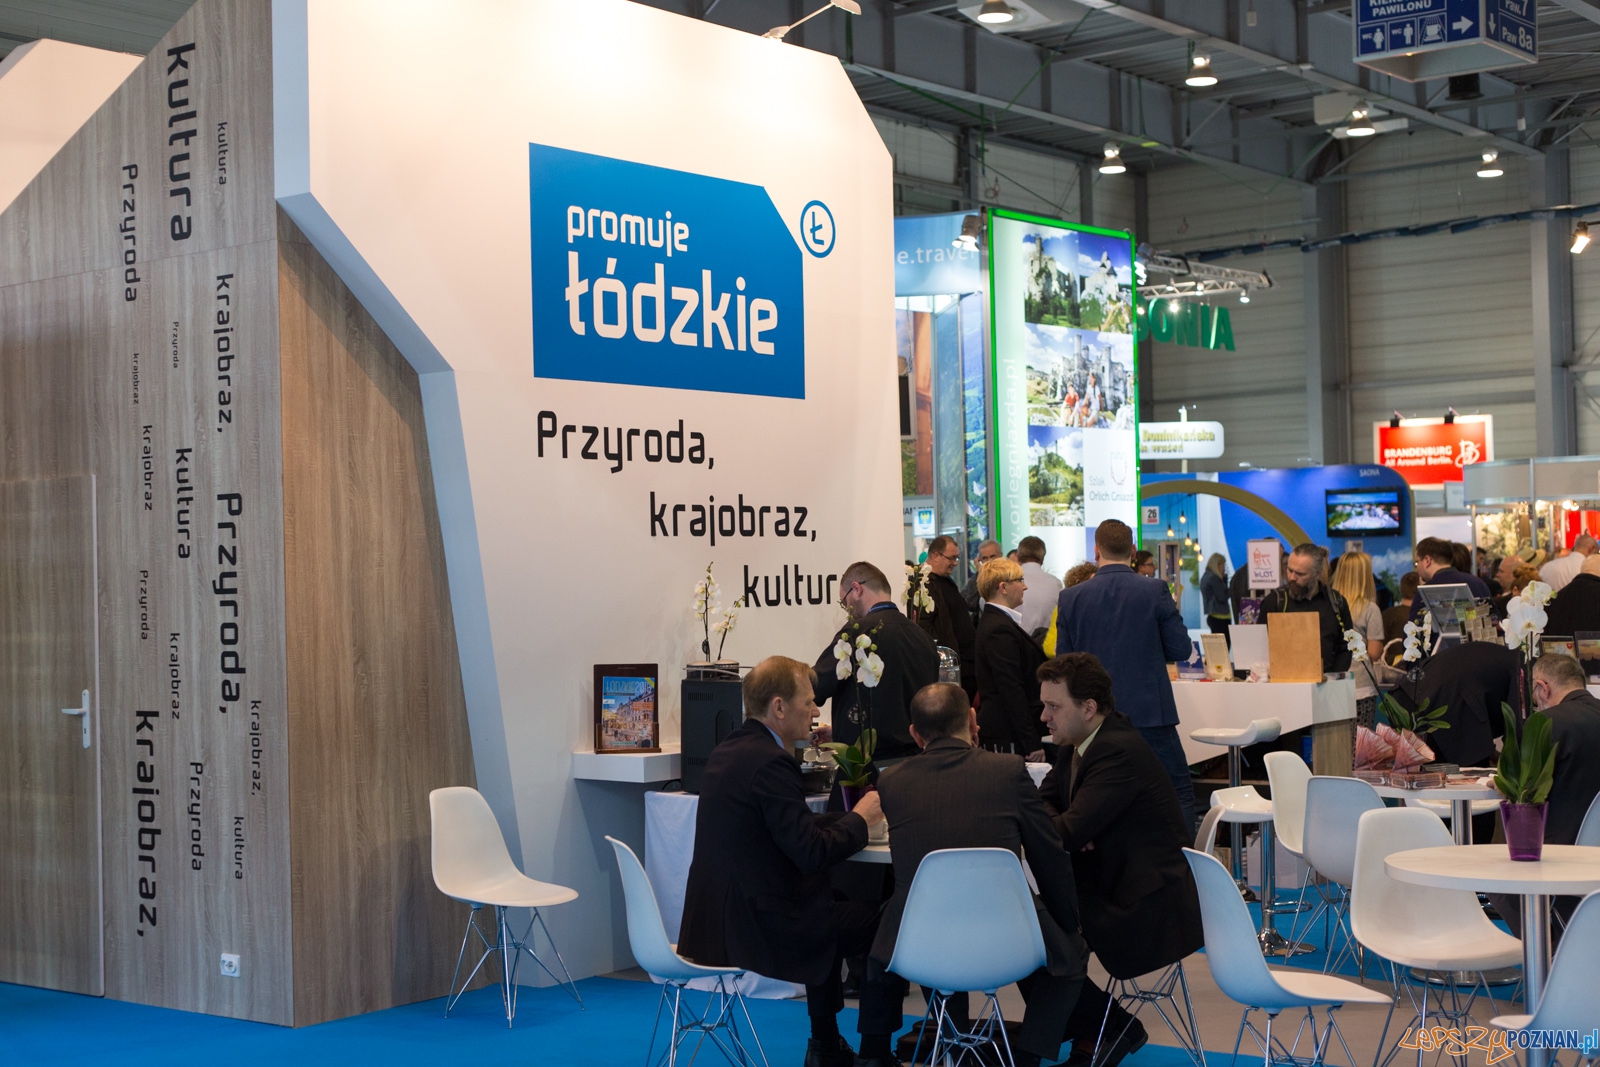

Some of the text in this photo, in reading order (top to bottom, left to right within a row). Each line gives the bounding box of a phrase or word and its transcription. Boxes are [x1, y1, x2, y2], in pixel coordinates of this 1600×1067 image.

[1372, 0, 1431, 17] PAWILONU
[1502, 26, 1533, 50] Paw 8a
[167, 43, 197, 241] kultura
[217, 122, 228, 186] kultura
[119, 163, 141, 302] Przyroda
[567, 205, 690, 257] promuje
[810, 211, 824, 246] Ł
[565, 251, 778, 355] łódzkie
[172, 321, 180, 369] Przyroda
[214, 273, 235, 433] krajobraz,
[132, 352, 140, 405] krajobraz
[142, 425, 154, 511] krajobraz
[537, 410, 714, 474] Przyroda,
[1384, 445, 1453, 458] BRANDENBURG
[1397, 458, 1426, 467] Around
[175, 448, 193, 559] kultura
[1089, 475, 1105, 486] Szlak
[1089, 491, 1109, 501] Orlich
[650, 491, 817, 546] krajobraz,
[1147, 508, 1157, 519] 26
[138, 569, 149, 640] Przyroda
[212, 493, 246, 713] Przyroda,
[743, 565, 844, 607] kultur
[169, 632, 181, 720] krajobraz
[249, 700, 262, 796] krajobraz,
[132, 711, 162, 937] krajobraz,
[187, 762, 205, 871] Przyroda
[234, 816, 244, 880] kultura
